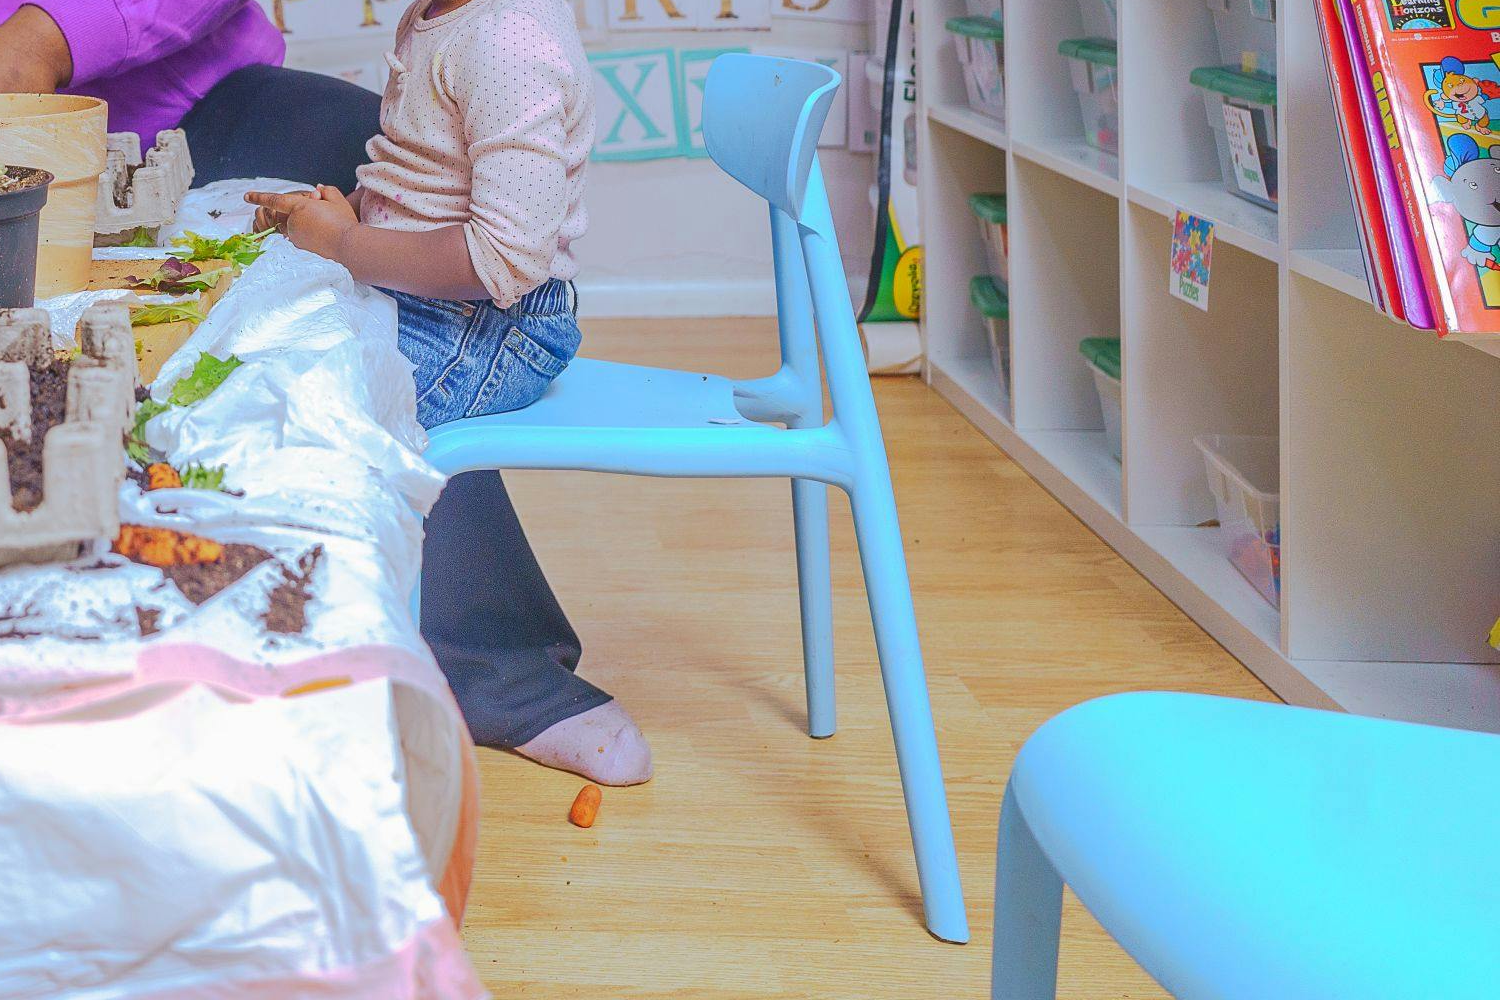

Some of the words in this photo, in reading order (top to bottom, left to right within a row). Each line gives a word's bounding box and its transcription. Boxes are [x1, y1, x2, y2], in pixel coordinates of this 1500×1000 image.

[1392, 4, 1444, 16] Horizons
[597, 62, 668, 144] X
[1356, 3, 1376, 67] KINDERGARTEN
[1372, 70, 1401, 150] GIANT
[1406, 199, 1420, 238] Workbook
